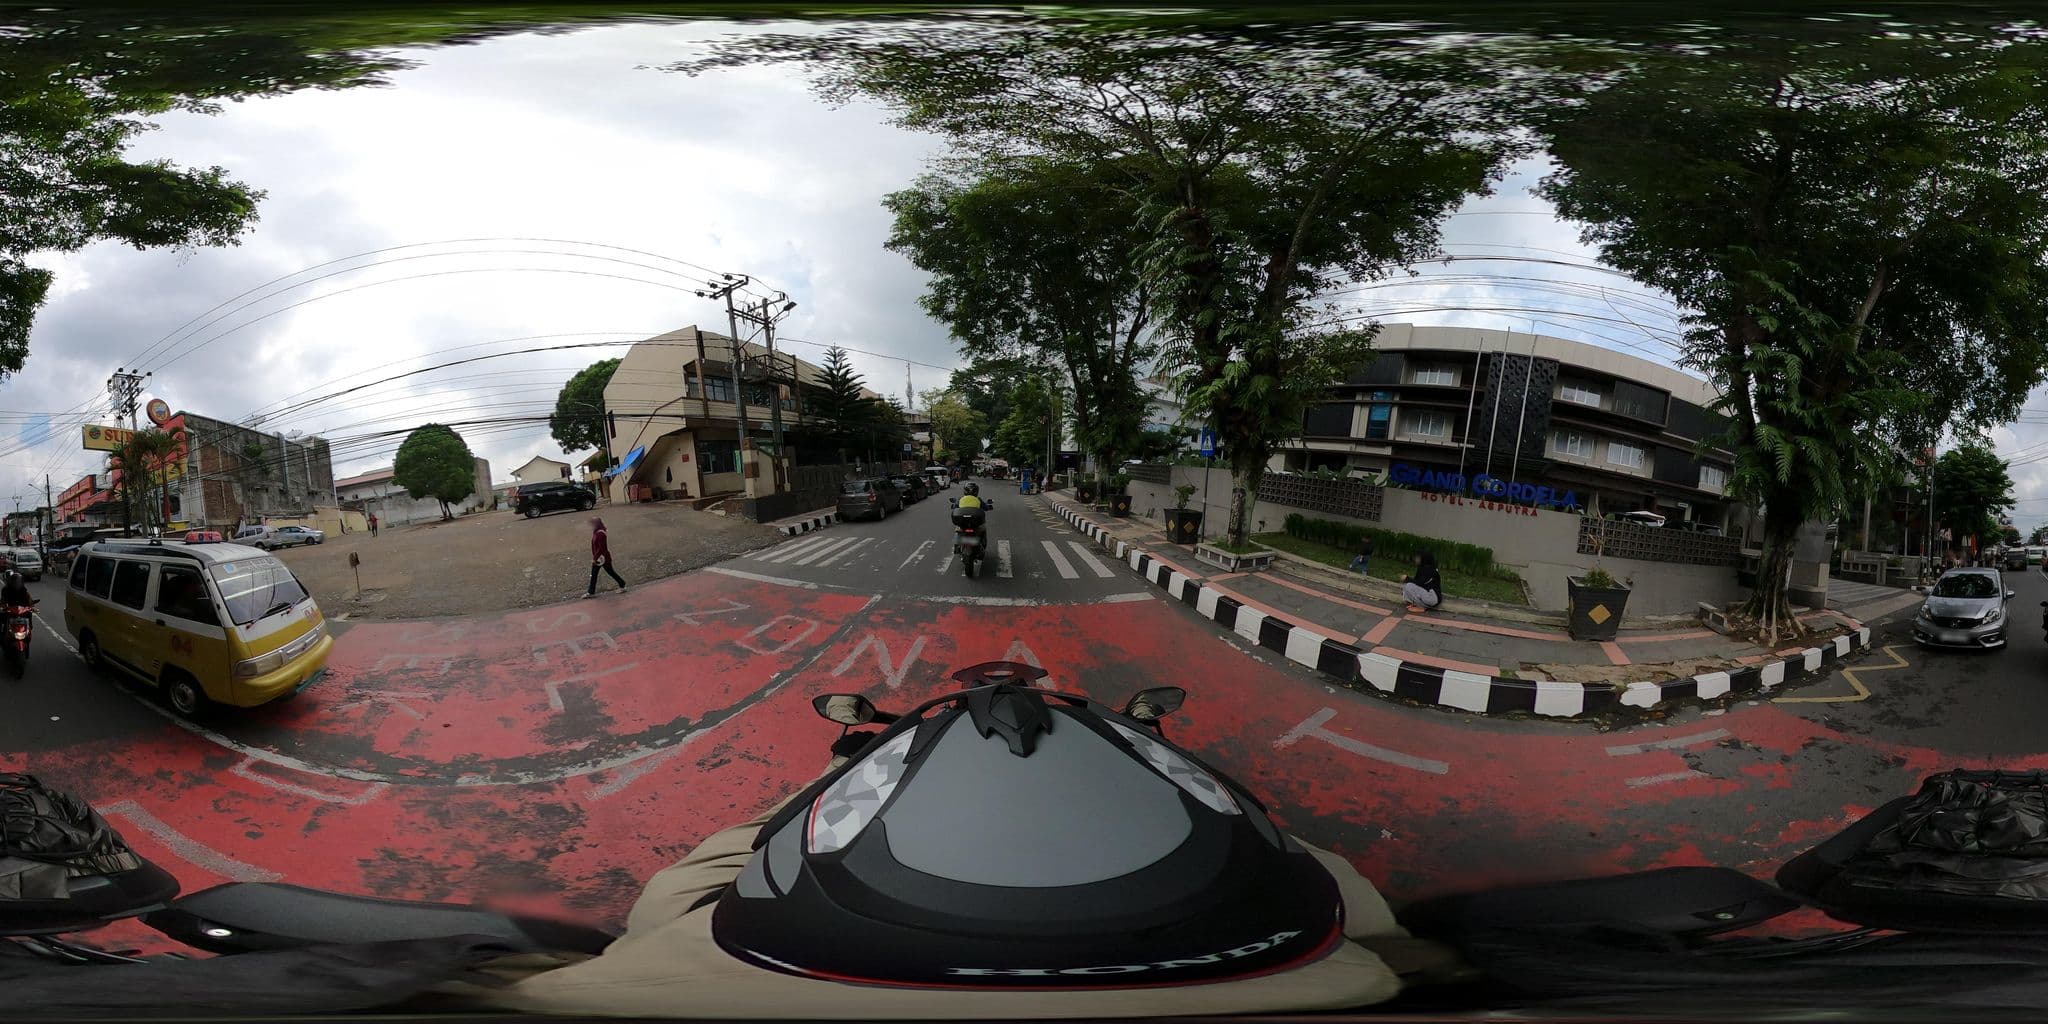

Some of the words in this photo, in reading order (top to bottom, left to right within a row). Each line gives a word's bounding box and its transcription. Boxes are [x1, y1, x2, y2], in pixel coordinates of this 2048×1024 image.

[1391, 463, 1466, 490] GRAND
[1472, 474, 1577, 507] CORDELA
[1421, 491, 1464, 506] HOTEL
[947, 930, 1302, 976] HONDA
